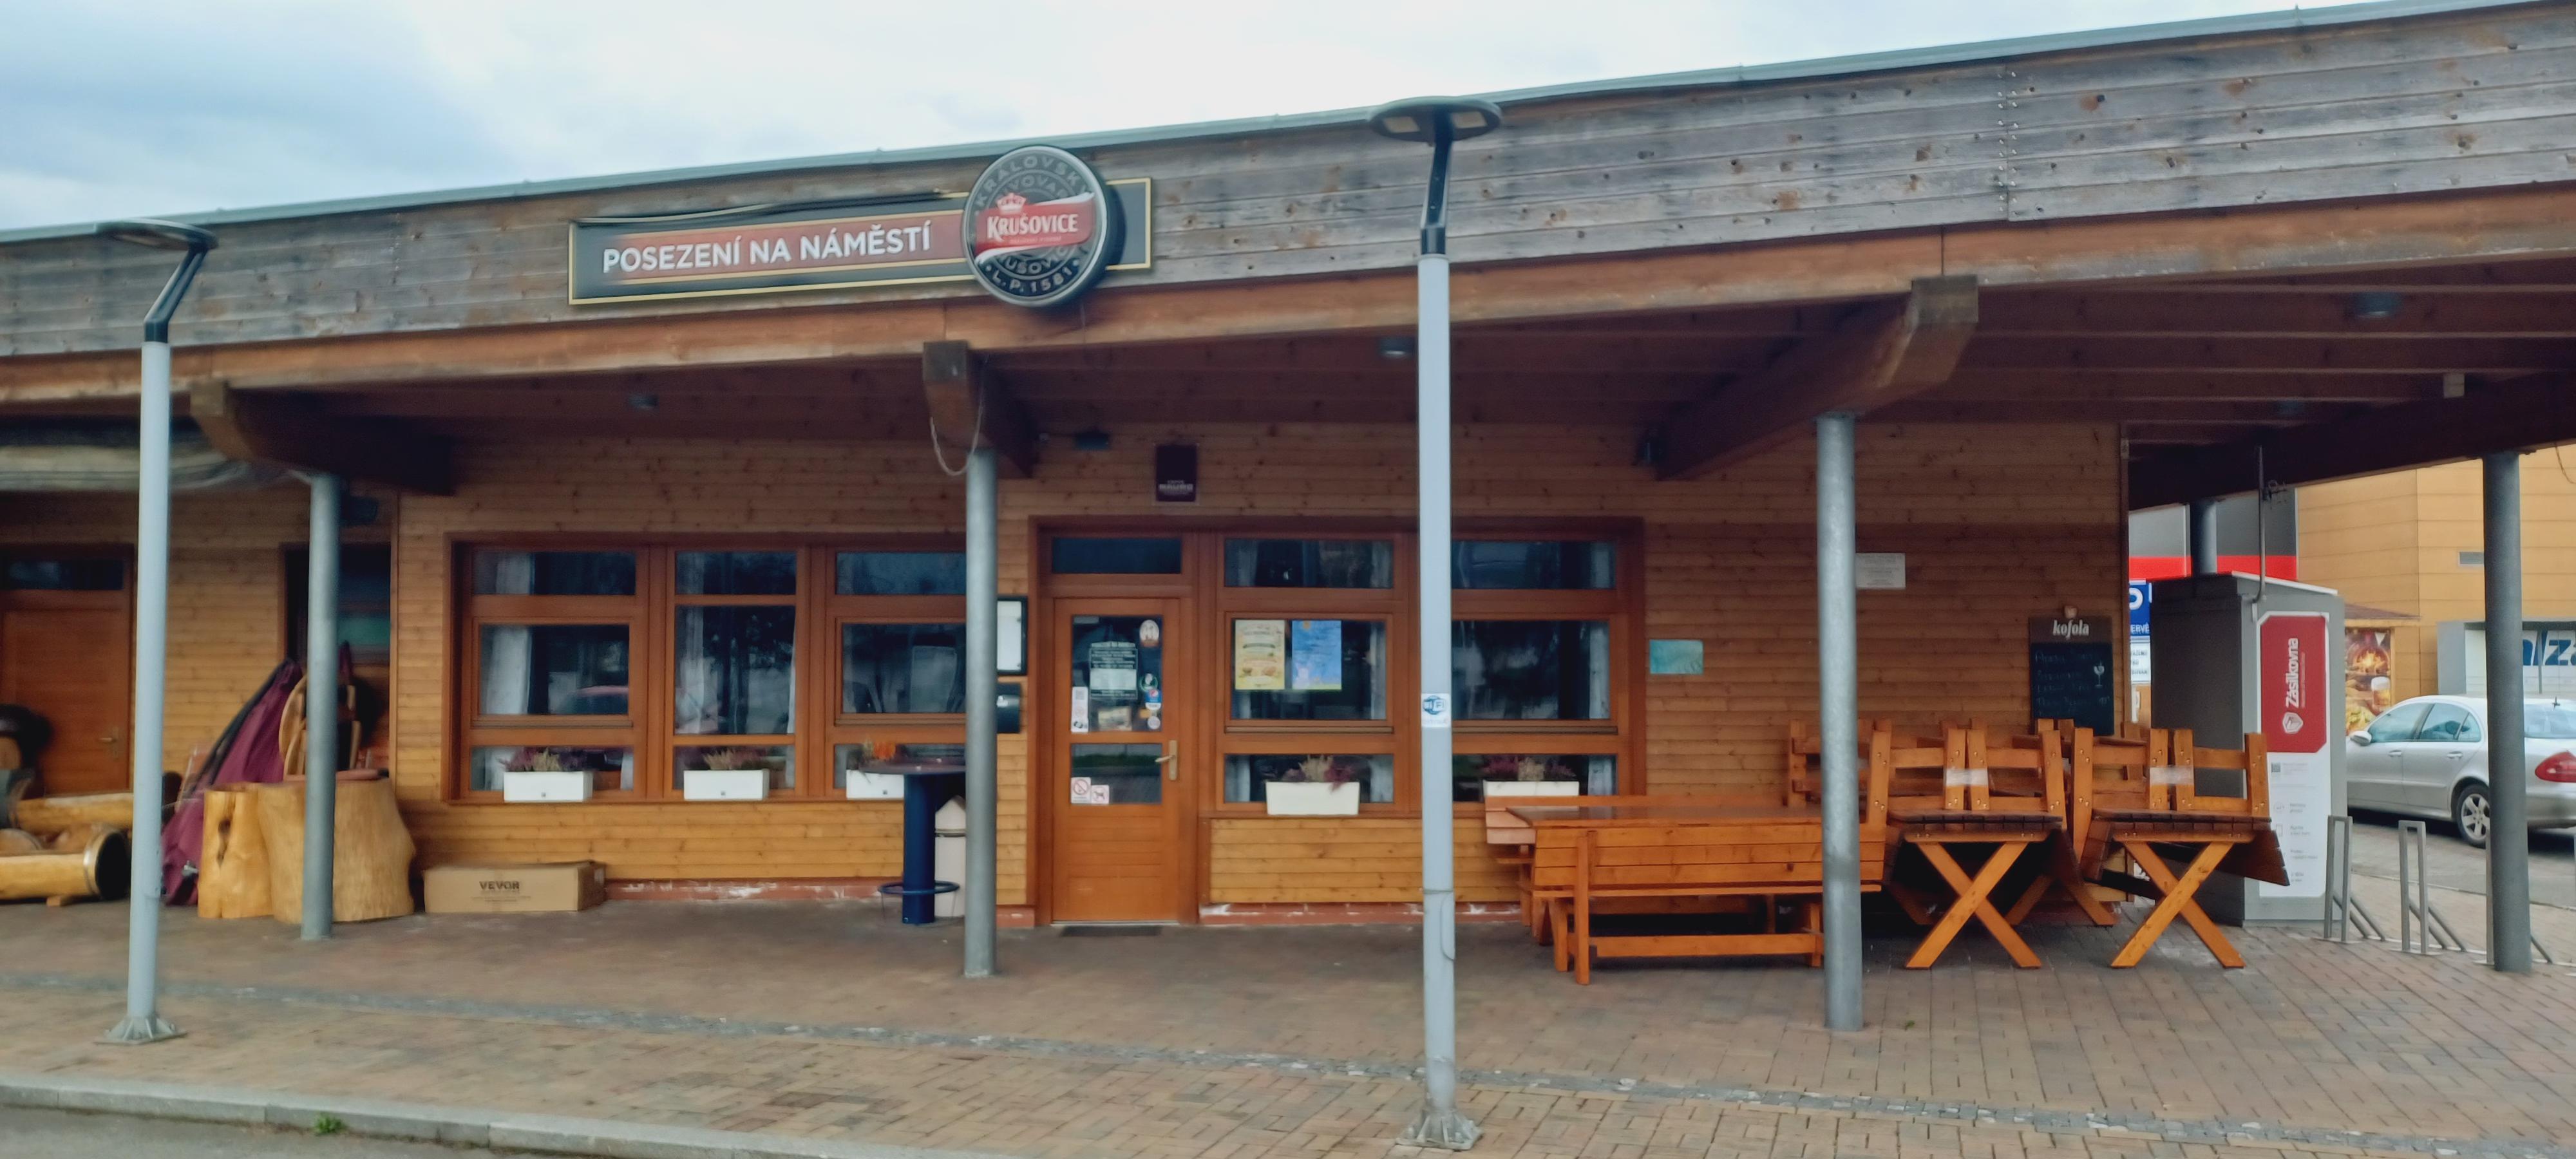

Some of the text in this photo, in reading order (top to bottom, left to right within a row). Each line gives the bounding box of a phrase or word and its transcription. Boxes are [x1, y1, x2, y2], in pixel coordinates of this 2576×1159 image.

[987, 213, 1079, 243] KRUŠOVICE
[603, 220, 932, 274] POSEZENÍ NA NÁMĚSTÍ
[2052, 619, 2090, 640] kofola
[2286, 637, 2299, 708] Zásilkovna
[478, 880, 520, 890] VEVOR
